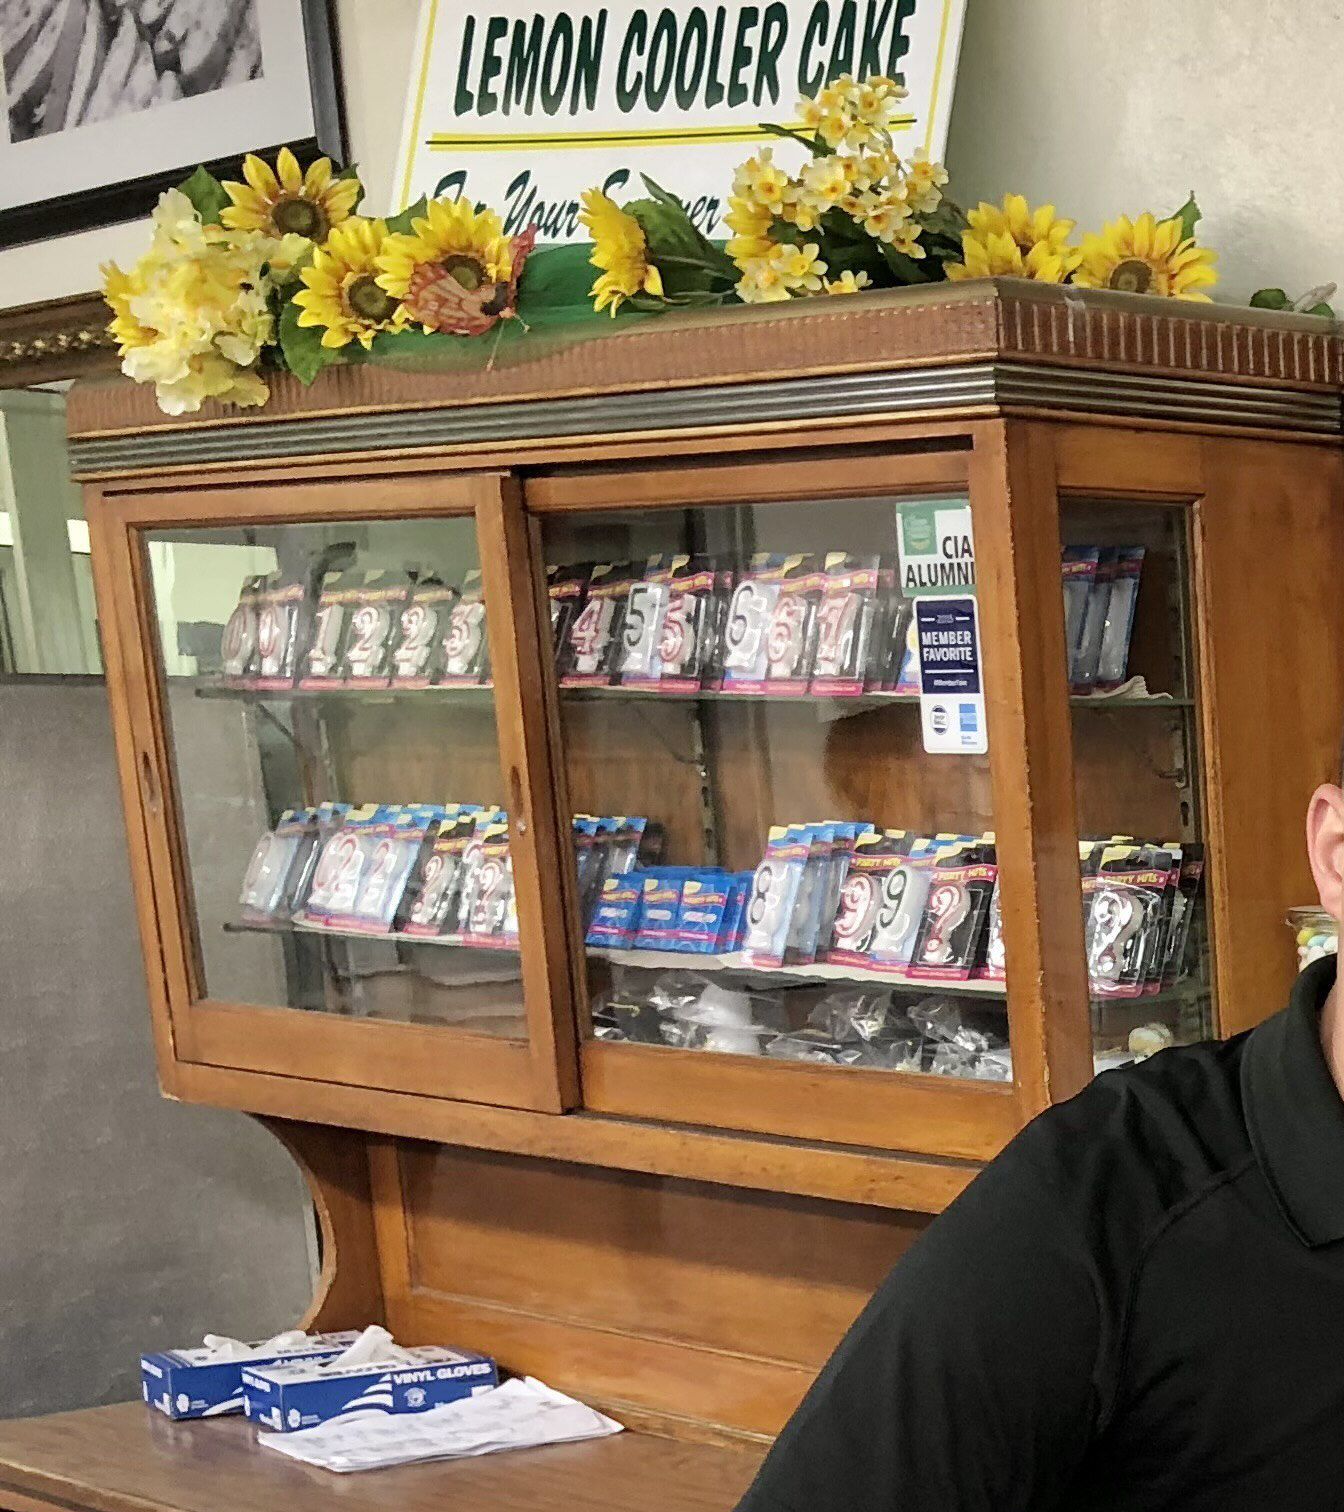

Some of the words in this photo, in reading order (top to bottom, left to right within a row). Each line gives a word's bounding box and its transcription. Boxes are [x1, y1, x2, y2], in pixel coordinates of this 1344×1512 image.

[454, 9, 608, 117] LEMON
[615, 1, 790, 114] COOLER
[797, 0, 917, 99] CAKE
[942, 535, 974, 559] CIA
[905, 562, 976, 589] ALUMNI
[921, 630, 972, 646] MEMBER
[923, 647, 974, 662] FAVORITE
[393, 1369, 437, 1385] VINYL
[437, 1363, 492, 1379] GLOVES
